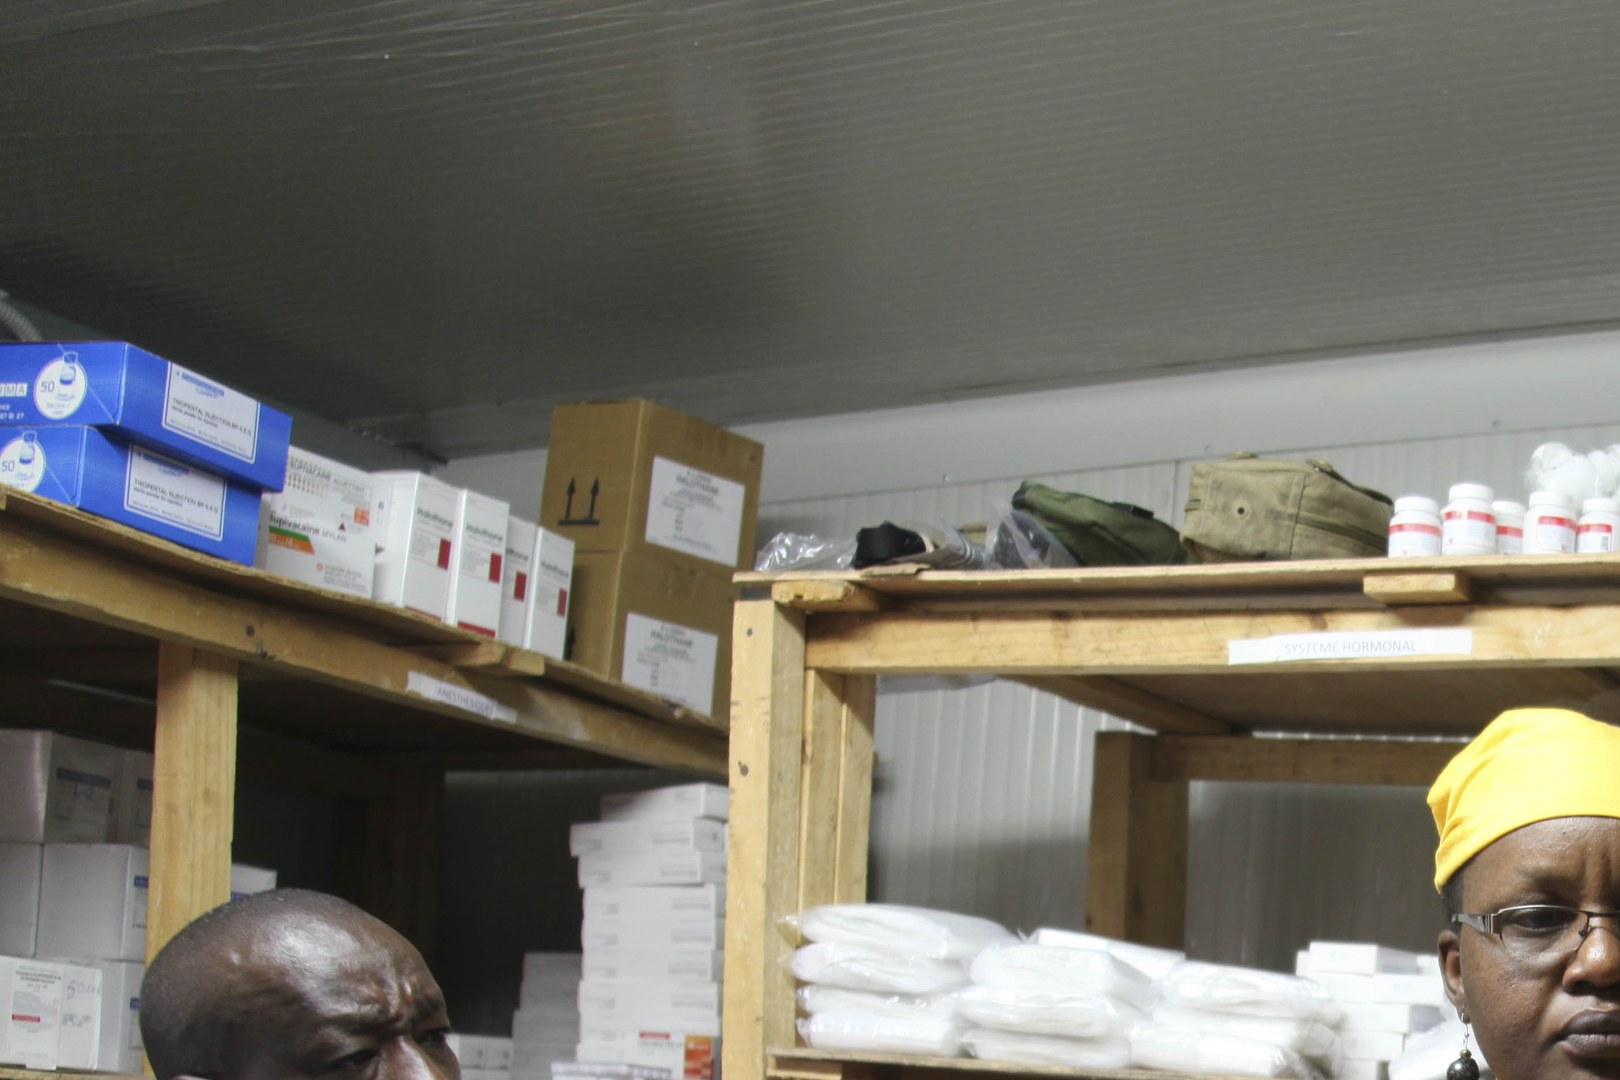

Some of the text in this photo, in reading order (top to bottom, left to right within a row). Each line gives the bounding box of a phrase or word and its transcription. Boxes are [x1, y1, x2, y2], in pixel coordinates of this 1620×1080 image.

[41, 381, 55, 393] 50
[1, 460, 15, 473] 50
[1285, 640, 1417, 656] SYSTEME HORMONAL
